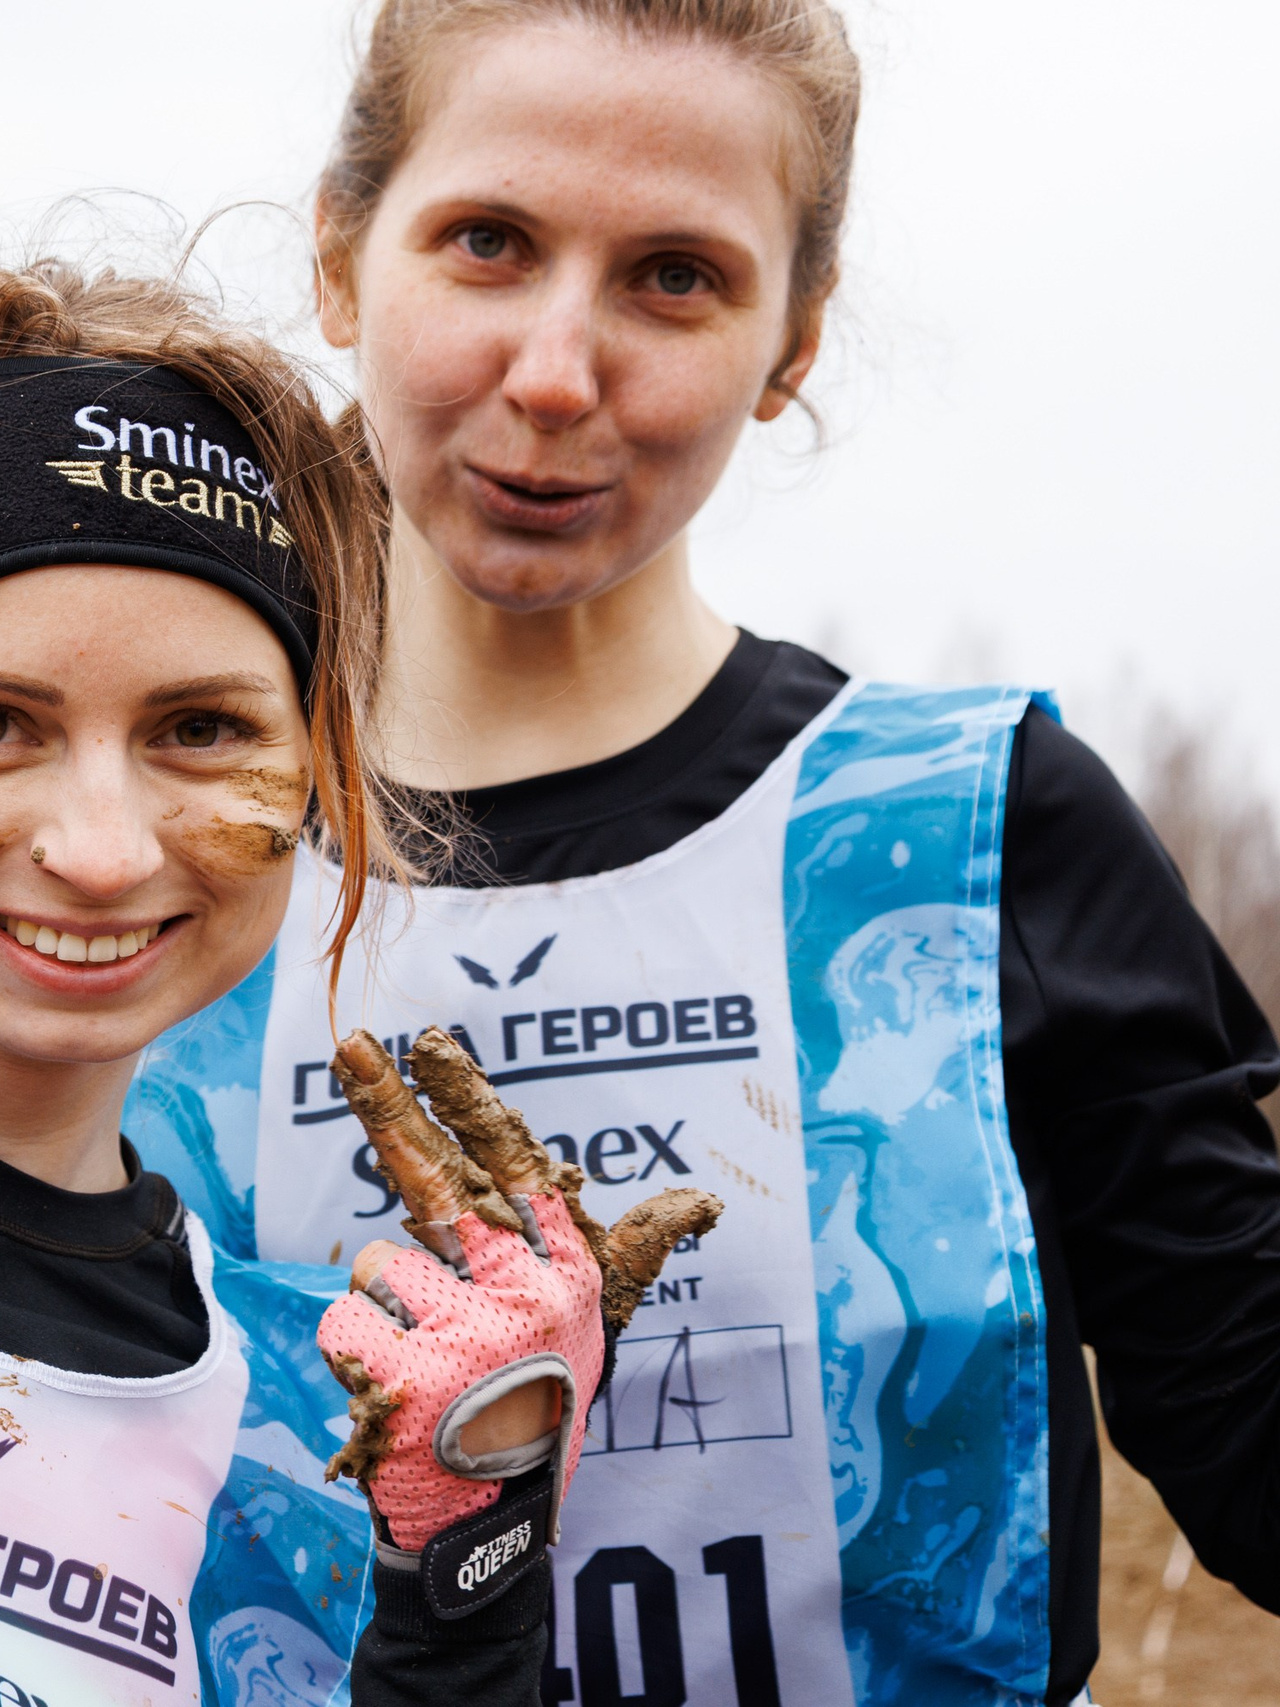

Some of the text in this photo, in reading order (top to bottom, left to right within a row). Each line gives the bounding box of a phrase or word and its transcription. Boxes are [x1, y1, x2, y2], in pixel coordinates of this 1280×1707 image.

[74, 405, 280, 511] Sminex
[116, 454, 262, 540] team
[501, 994, 757, 1062] ГЕРОЕВ
[457, 1531, 531, 1591] QUEEN
[479, 1520, 531, 1558] FITNESS
